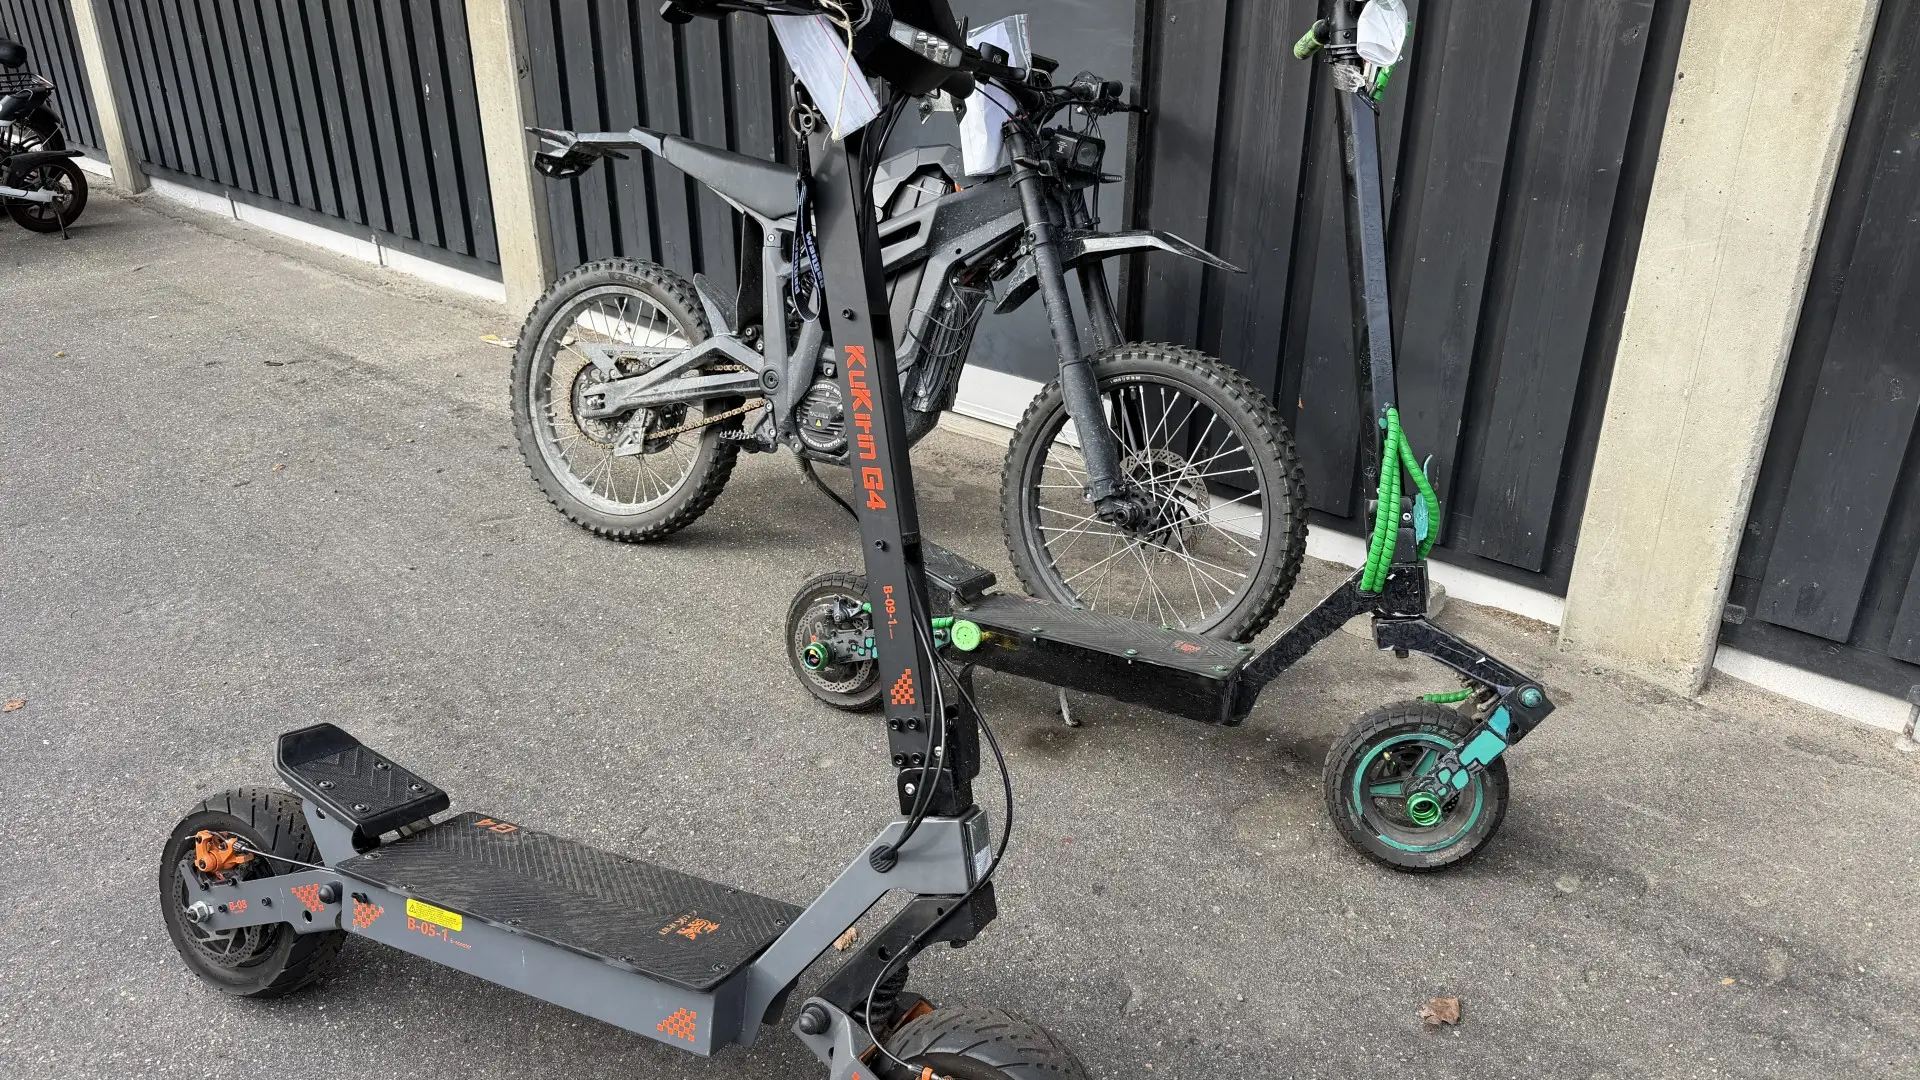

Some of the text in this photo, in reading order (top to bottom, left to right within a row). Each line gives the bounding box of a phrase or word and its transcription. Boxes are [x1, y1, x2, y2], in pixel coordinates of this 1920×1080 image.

[844, 345, 887, 510] KuKirin G4
[883, 585, 898, 625] B-09-1
[228, 899, 248, 911] B-08
[407, 916, 449, 942] B-05-1
